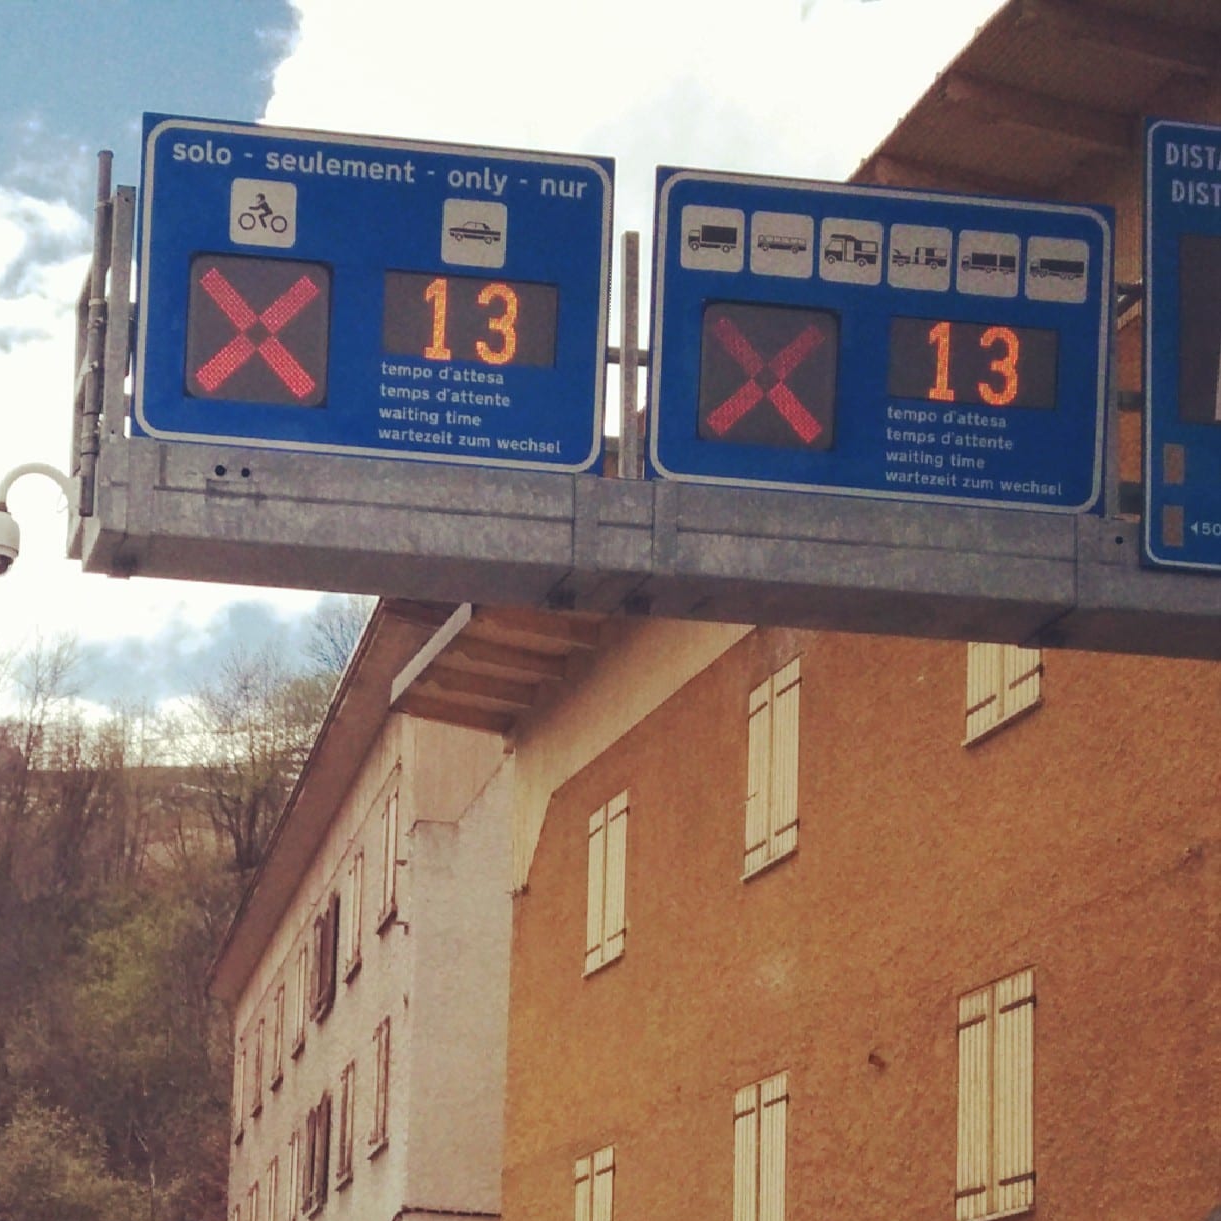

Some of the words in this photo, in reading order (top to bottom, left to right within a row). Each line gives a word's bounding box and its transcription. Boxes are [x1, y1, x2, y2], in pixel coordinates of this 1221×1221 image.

[1164, 141, 1221, 171] DIST
[172, 140, 232, 165] solo
[265, 151, 416, 184] seulement
[447, 167, 508, 196] only
[540, 176, 588, 198] nur
[425, 278, 517, 365] 13
[381, 361, 432, 379] tempo
[438, 366, 505, 385] d'attesa
[928, 321, 1019, 406] 13
[381, 383, 430, 403] temps
[436, 388, 511, 407] d'attente
[379, 407, 439, 425] waiting
[445, 409, 482, 427] time
[886, 405, 937, 425] tempo
[942, 410, 1007, 429] d'attesa
[379, 429, 454, 446] wartezeit
[458, 434, 491, 448] zum
[496, 437, 561, 454] wechsel
[886, 427, 936, 446] temps
[940, 431, 1014, 450] d'attente
[885, 450, 944, 468] waiting
[950, 452, 986, 469] time
[885, 470, 957, 487] wartezeit
[962, 476, 995, 491] zum
[999, 480, 1062, 496] wechsel
